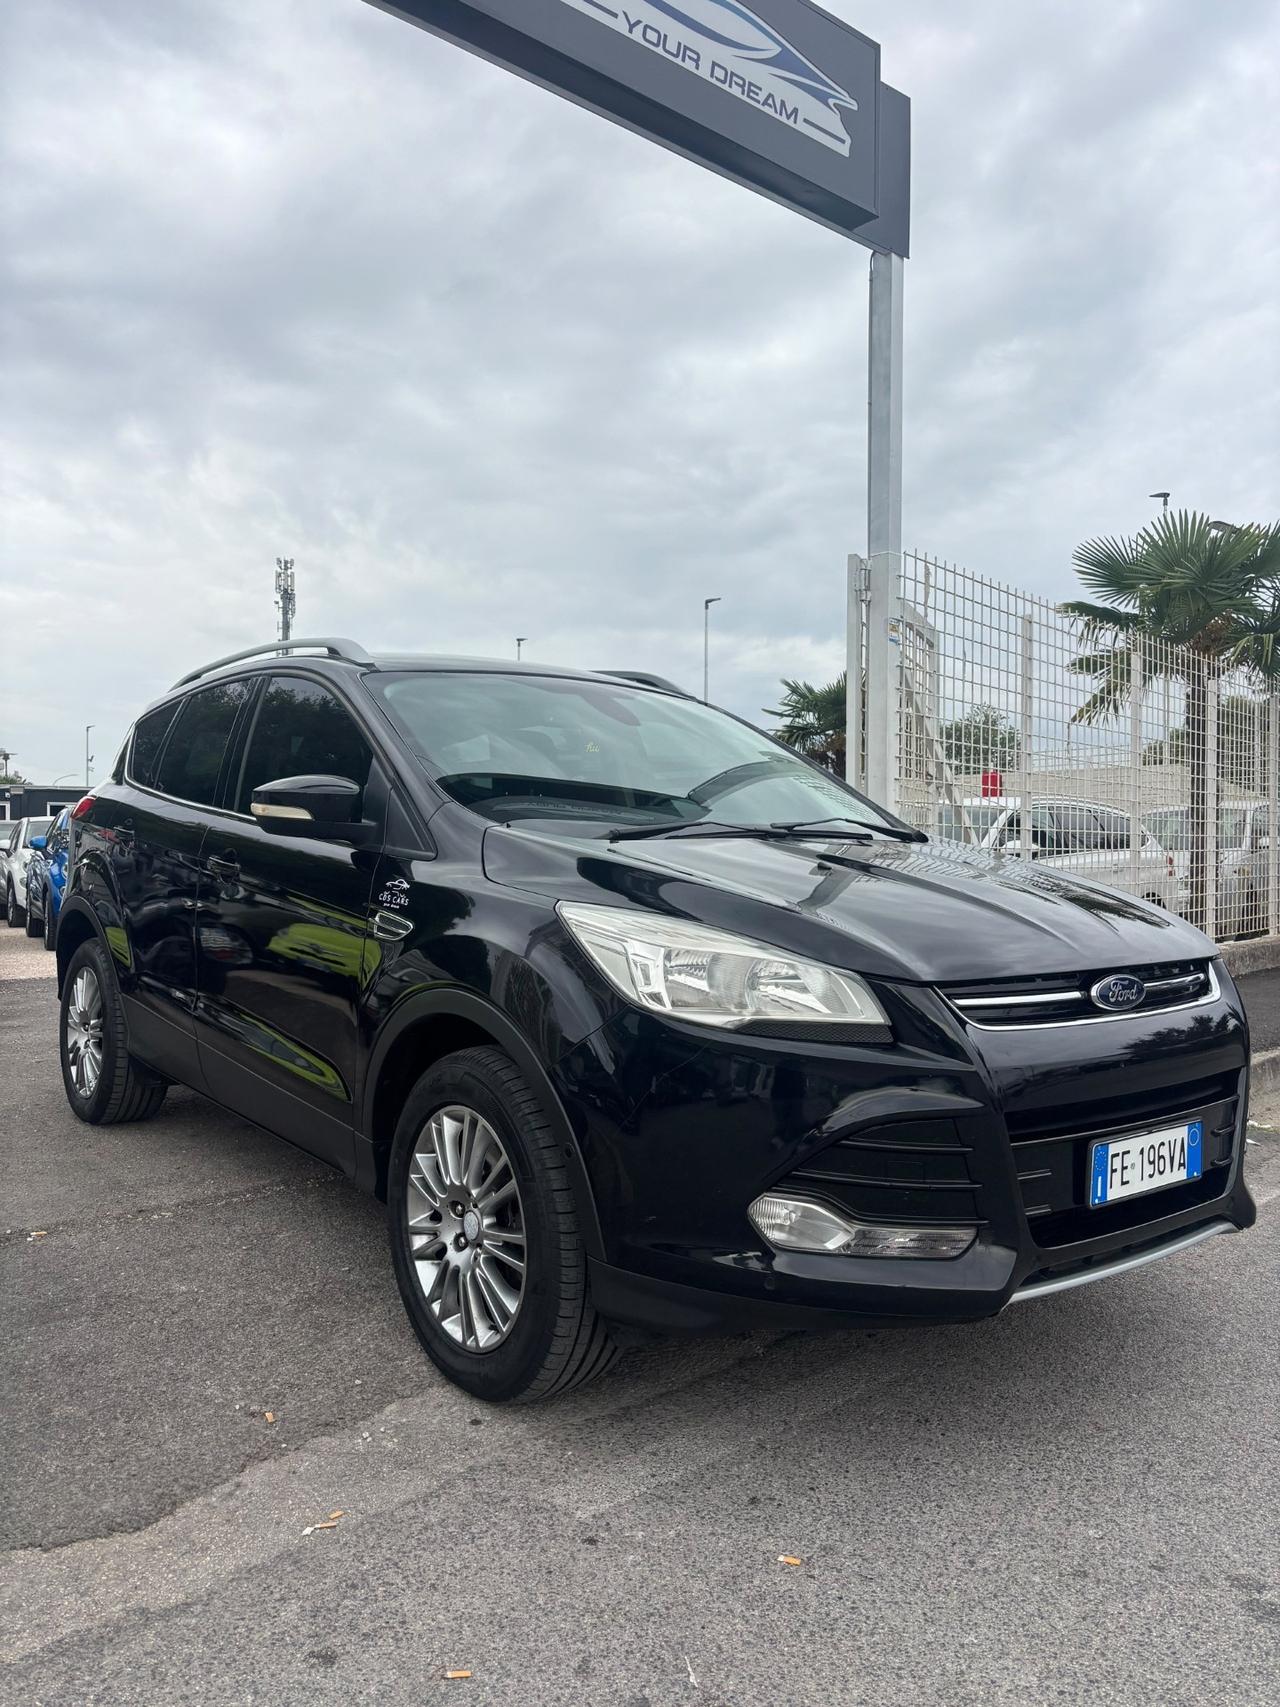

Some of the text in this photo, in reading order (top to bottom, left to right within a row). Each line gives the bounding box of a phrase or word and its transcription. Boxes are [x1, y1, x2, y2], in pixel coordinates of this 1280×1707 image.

[622, 10, 799, 124] YOUR DREAM
[1109, 980, 1137, 1002] Ford
[1110, 1137, 1186, 1189] FE 196VA
